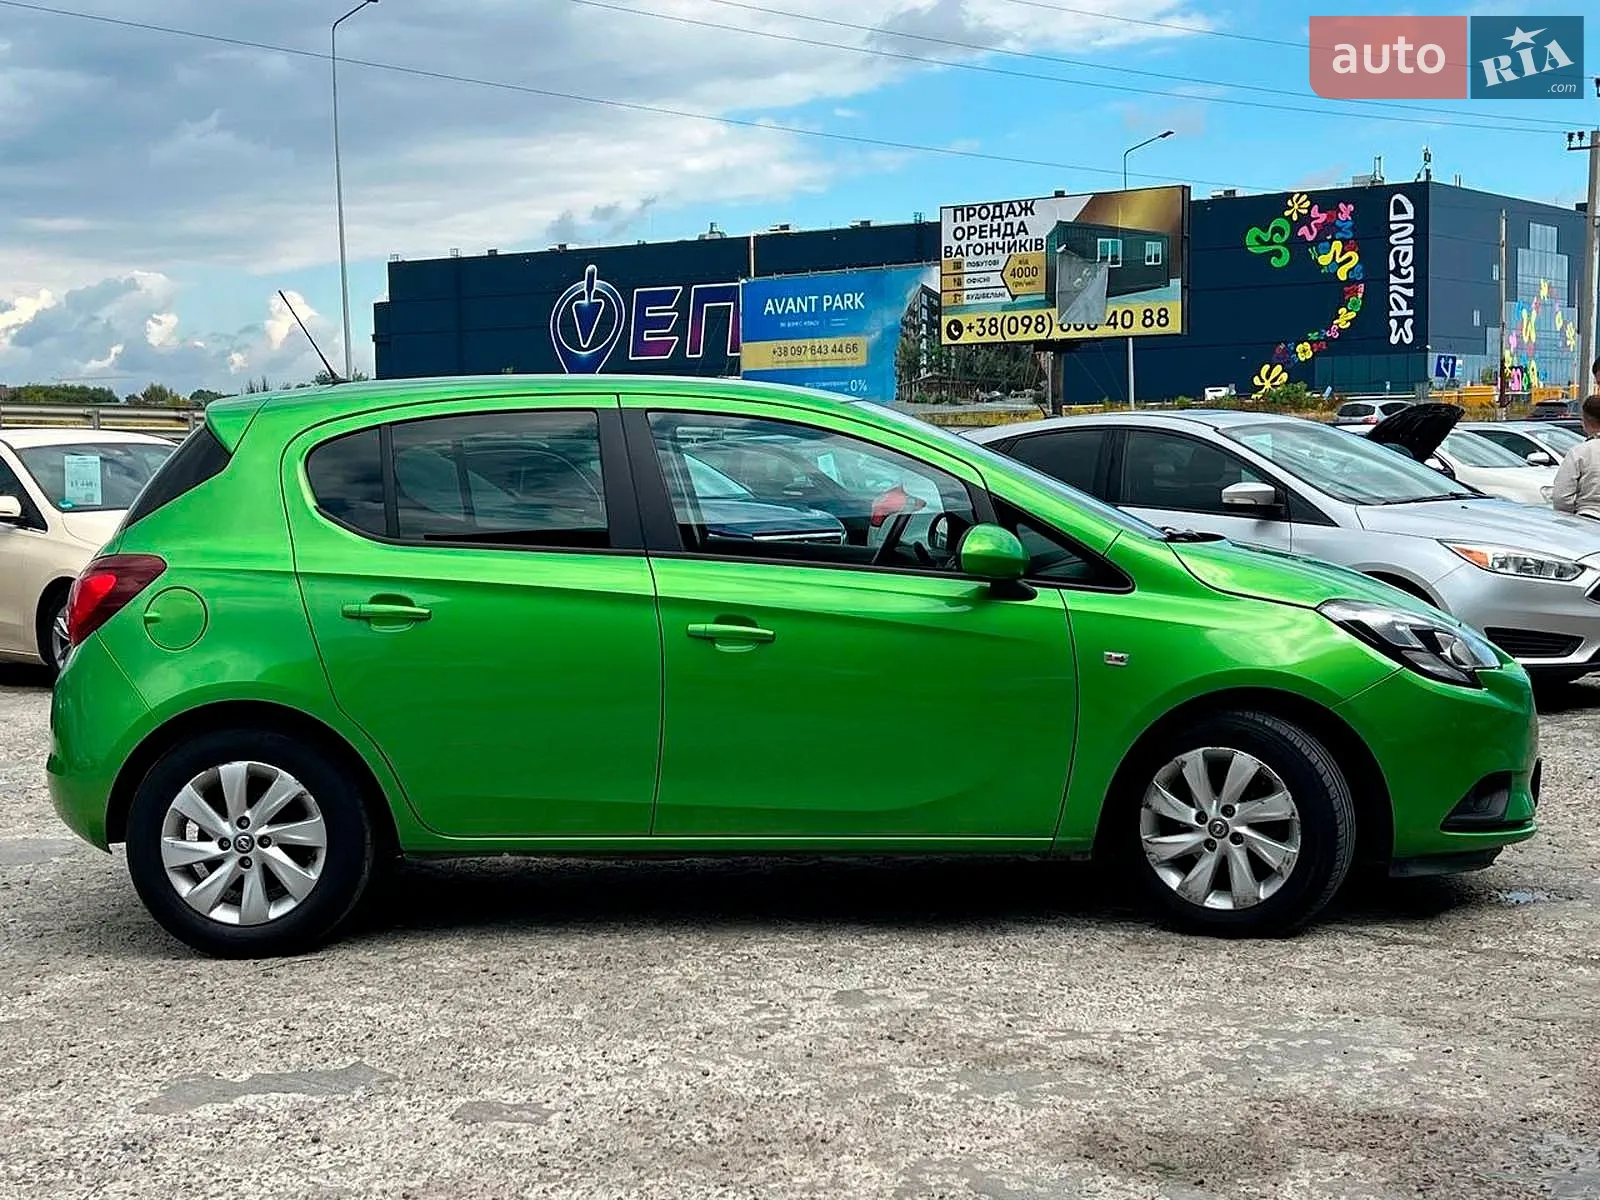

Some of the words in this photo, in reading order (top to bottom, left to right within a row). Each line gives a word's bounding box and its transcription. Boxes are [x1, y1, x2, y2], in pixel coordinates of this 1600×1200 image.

[953, 200, 1035, 223] ПРОДАЖ
[953, 221, 1029, 241] ОРЕНДА
[944, 238, 1044, 258] ВАГОНЧИКІВ
[1010, 266, 1038, 279] 4000
[763, 295, 819, 316] AVANT
[823, 292, 865, 312] PARK
[967, 312, 1053, 339] +38(098)
[1105, 309, 1134, 330] 40
[1141, 307, 1170, 328] 88
[850, 379, 867, 391] 0%
